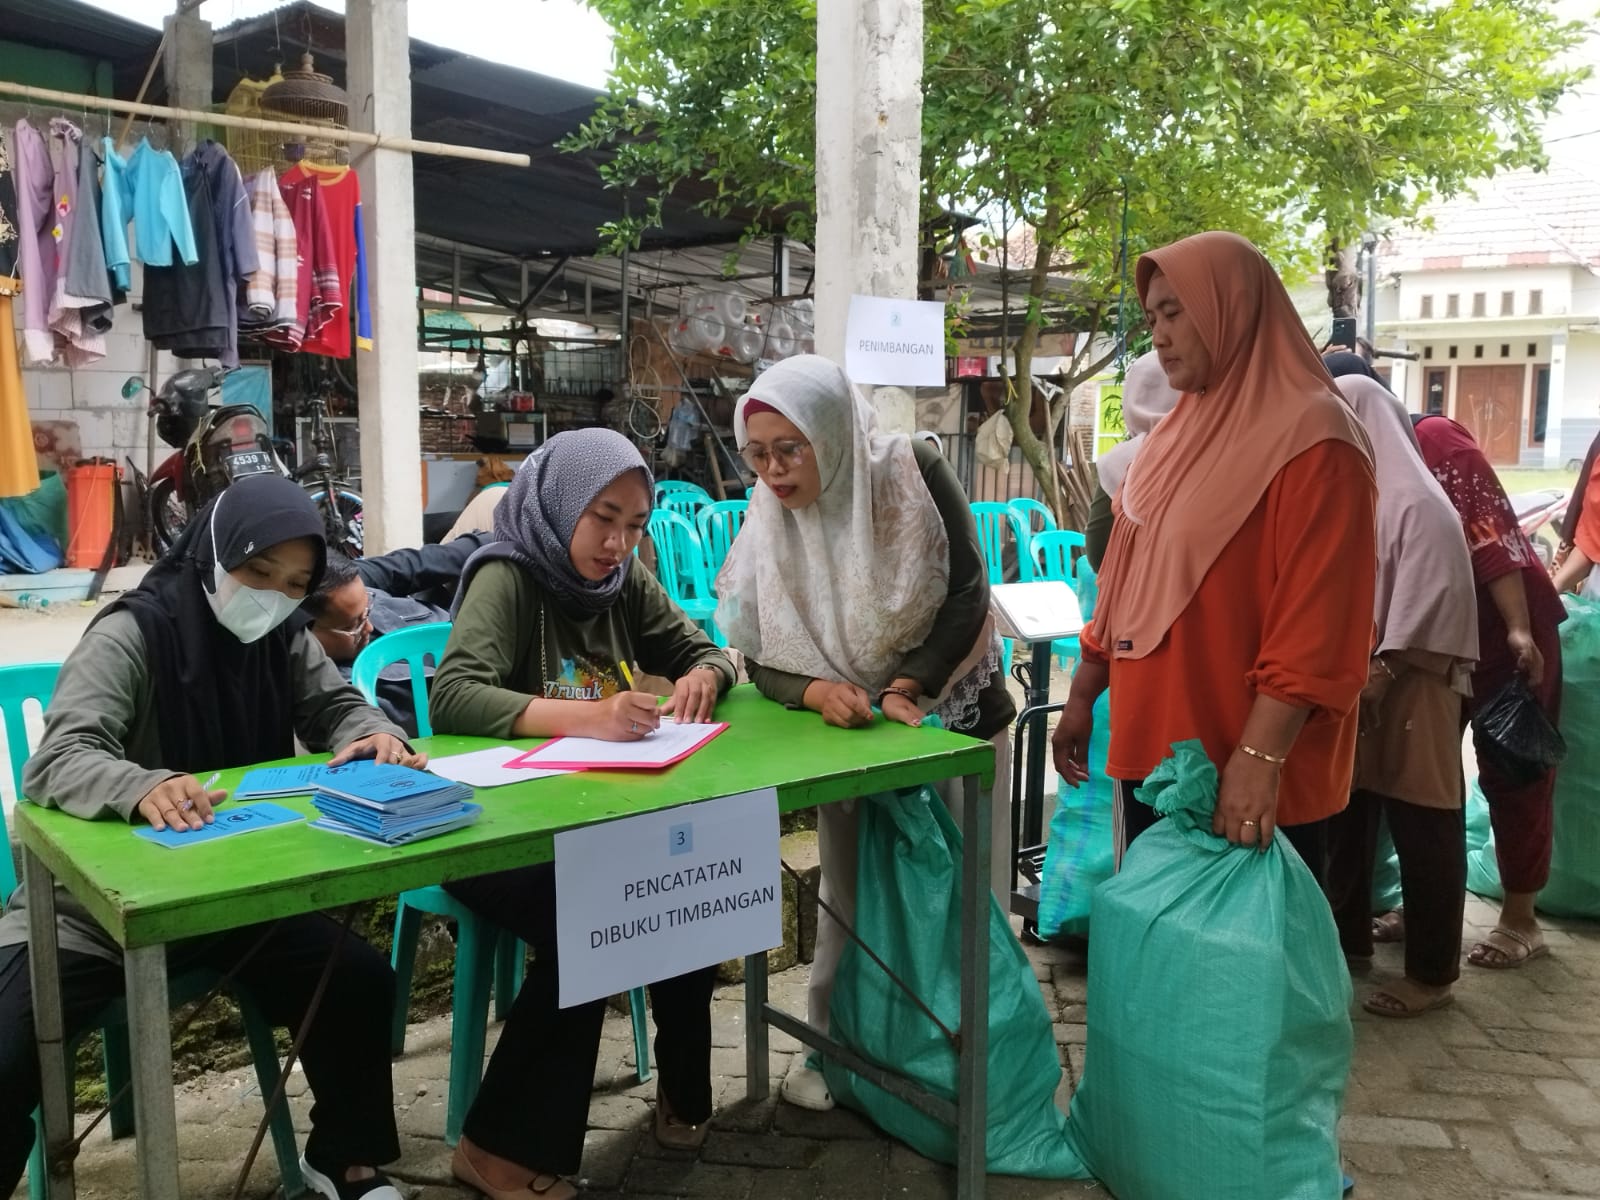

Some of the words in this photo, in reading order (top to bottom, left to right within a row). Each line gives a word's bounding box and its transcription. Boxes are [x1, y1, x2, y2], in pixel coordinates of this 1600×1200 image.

[859, 340, 934, 355] PENIMBANGAN
[233, 454, 259, 465] 4539
[545, 681, 604, 700] Trucuk
[676, 831, 686, 846] 3
[624, 857, 743, 901] PENCATATAN
[590, 914, 661, 949] DIBUKU
[666, 885, 775, 928] TIMBANGAN
